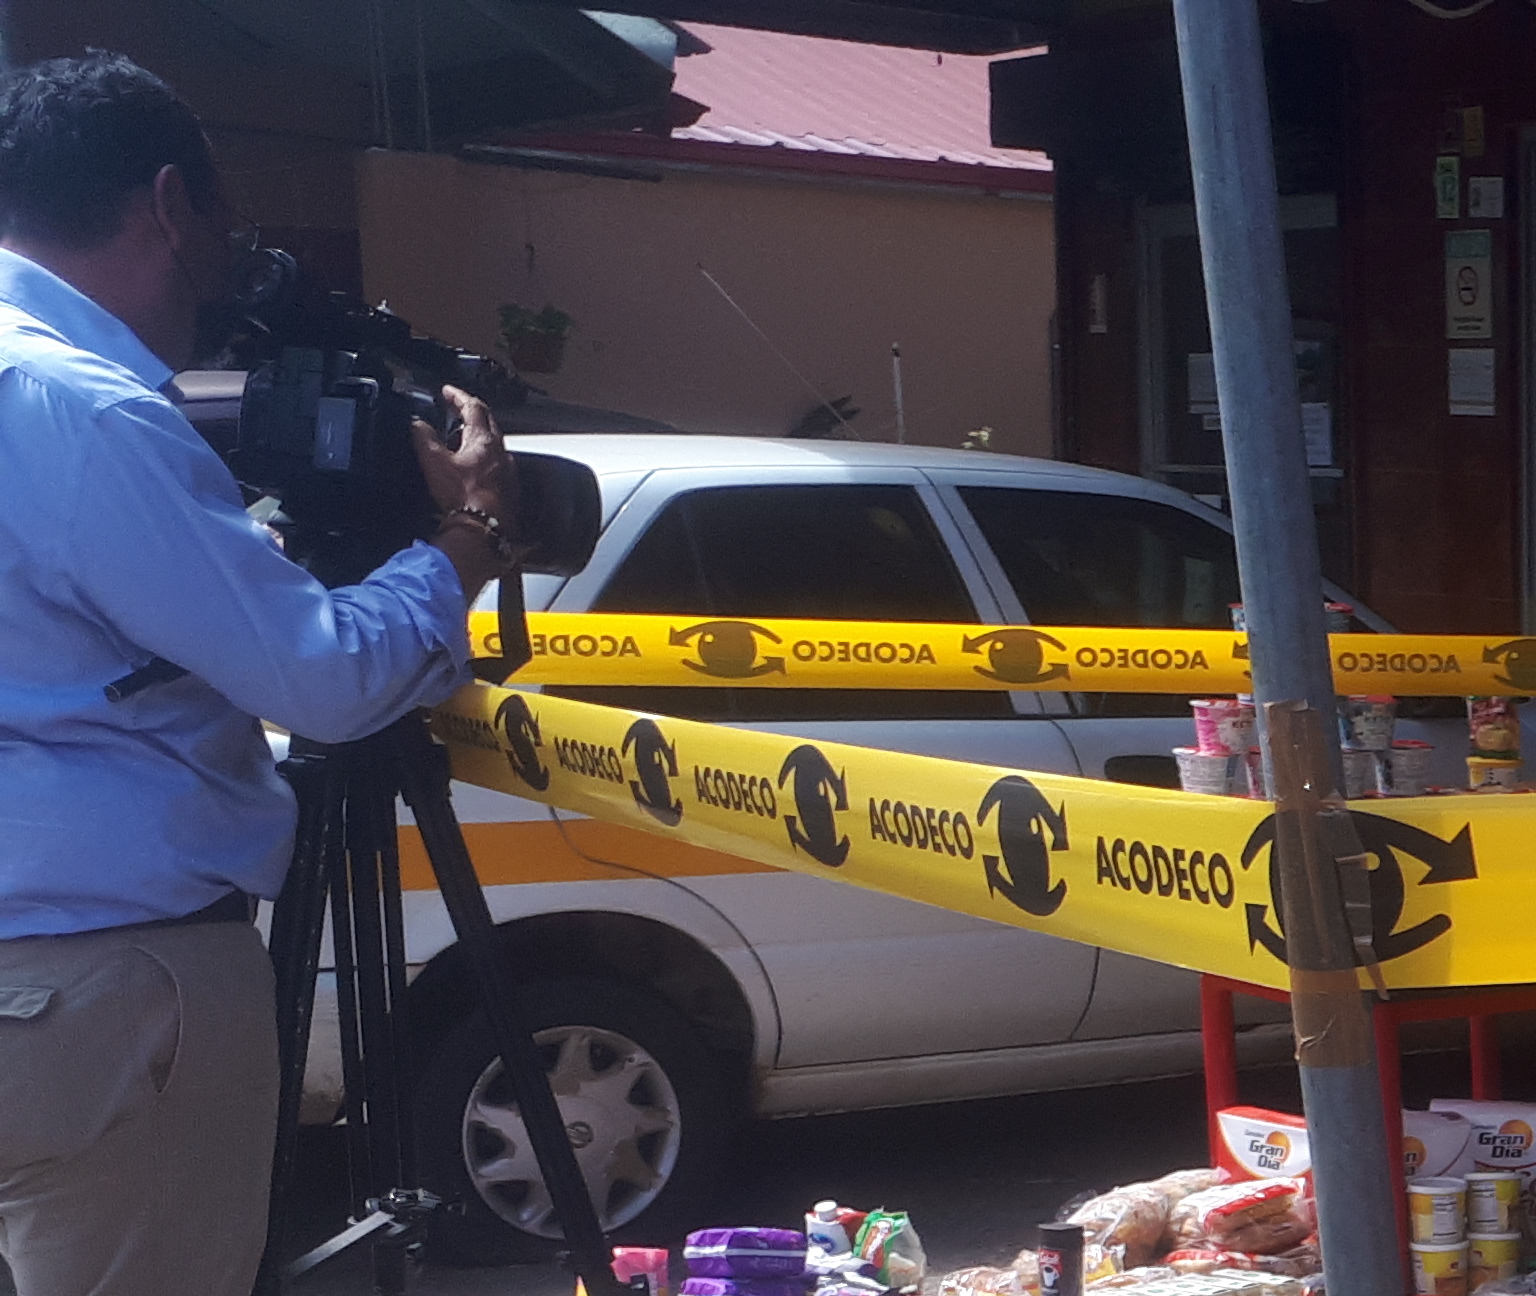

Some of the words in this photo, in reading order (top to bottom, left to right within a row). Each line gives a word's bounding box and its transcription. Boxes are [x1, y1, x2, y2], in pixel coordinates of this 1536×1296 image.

[552, 734, 625, 785] ACODECO
[691, 765, 776, 819] ACODECO
[867, 796, 975, 862] ACODECO
[1094, 835, 1234, 909] ACODECO
[1249, 1140, 1285, 1157] Gran
[1479, 1131, 1525, 1146] Gran
